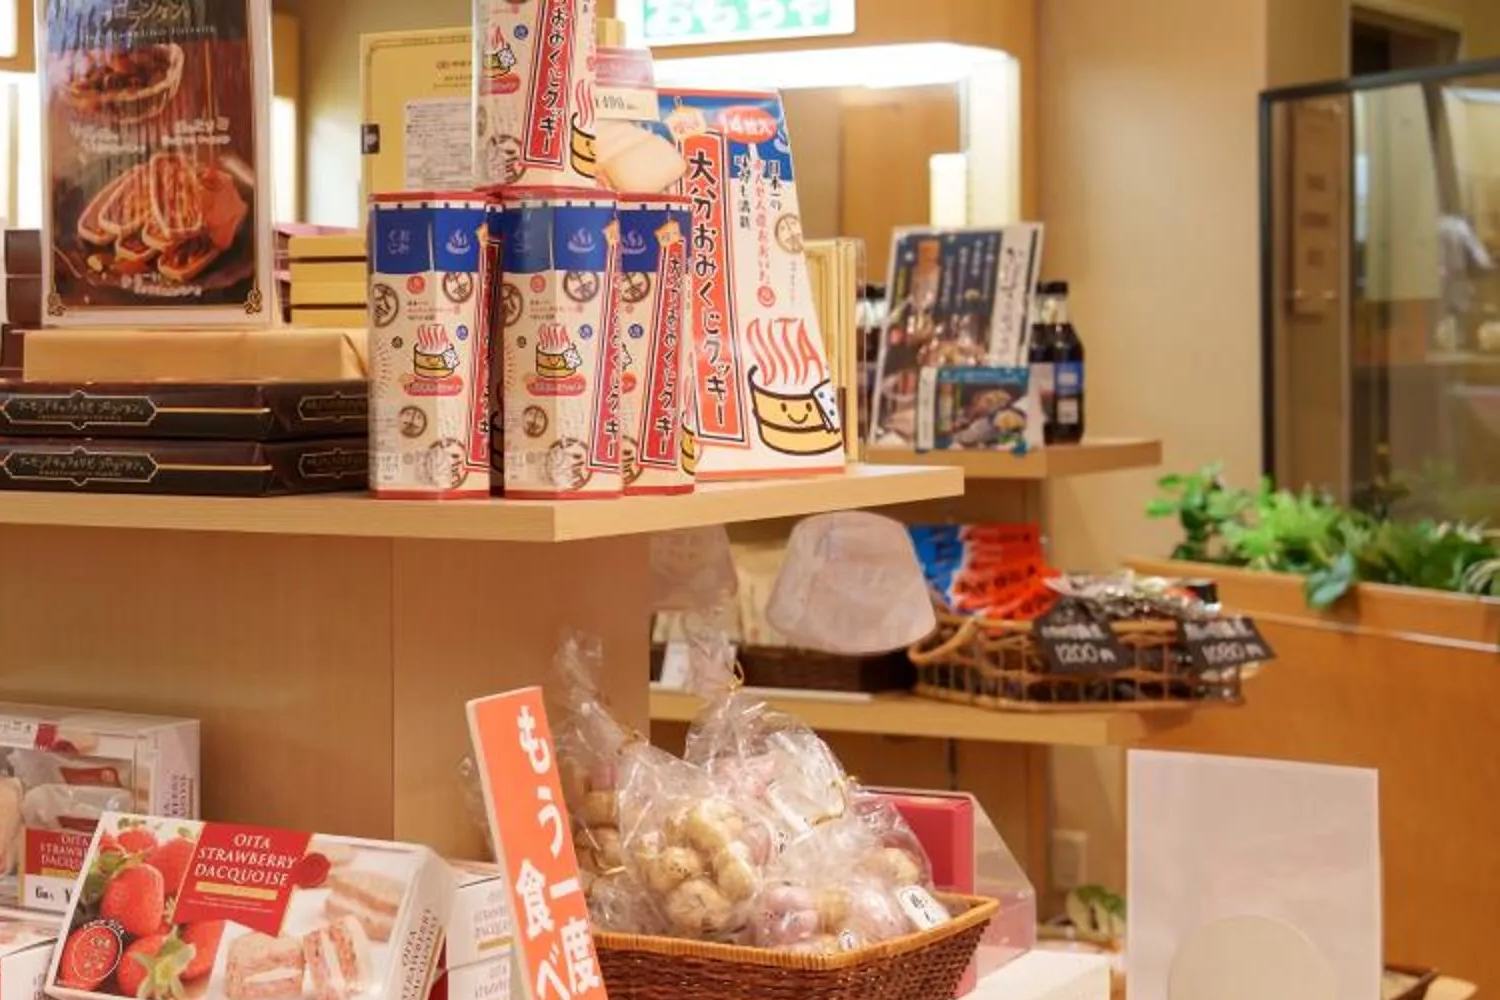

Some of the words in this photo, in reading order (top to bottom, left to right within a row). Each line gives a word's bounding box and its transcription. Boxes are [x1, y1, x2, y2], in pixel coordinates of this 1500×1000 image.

[539, 0, 569, 155] おみくじクッキー
[690, 151, 730, 425] 大分おみくじクッキー
[193, 864, 289, 887] DACQUOISE
[198, 847, 298, 869] STRAWBERRY
[233, 834, 271, 849] OITA
[516, 704, 602, 995] もう一度
